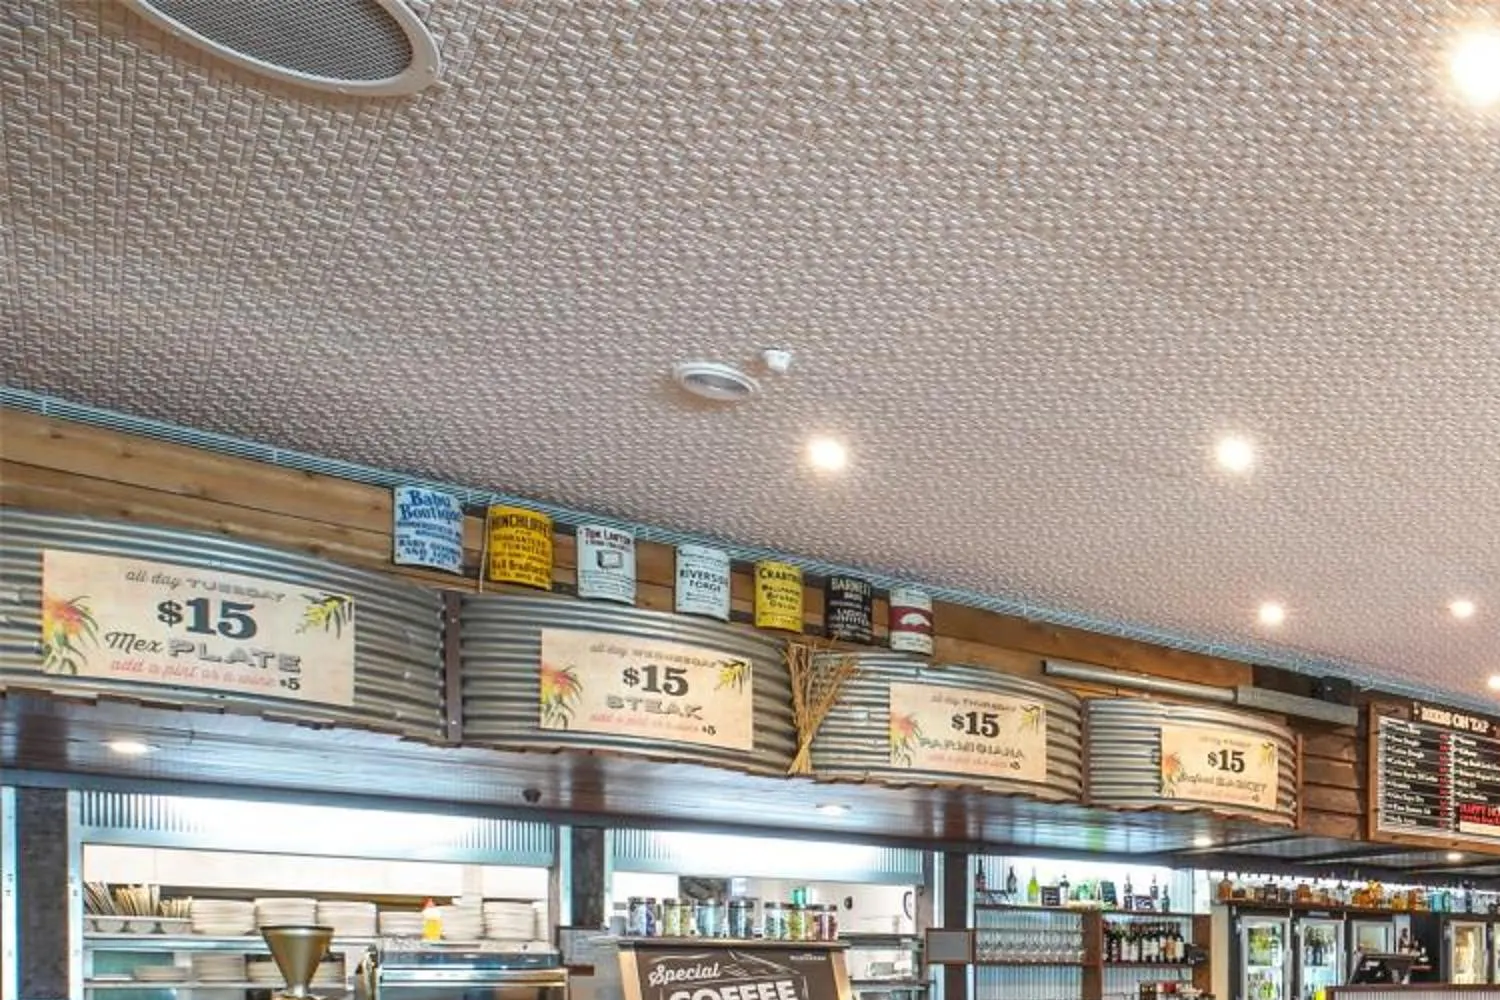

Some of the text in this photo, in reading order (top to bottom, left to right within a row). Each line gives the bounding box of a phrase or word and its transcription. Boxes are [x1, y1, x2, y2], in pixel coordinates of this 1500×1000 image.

[125, 569, 286, 603] all day TUESDAY
[157, 597, 258, 641] $15
[104, 631, 302, 675] Mex PLATE
[623, 664, 690, 697] $15
[607, 694, 704, 721] STEAK
[951, 711, 1000, 738] $15
[1207, 749, 1246, 774] $15
[648, 962, 722, 987] Special
